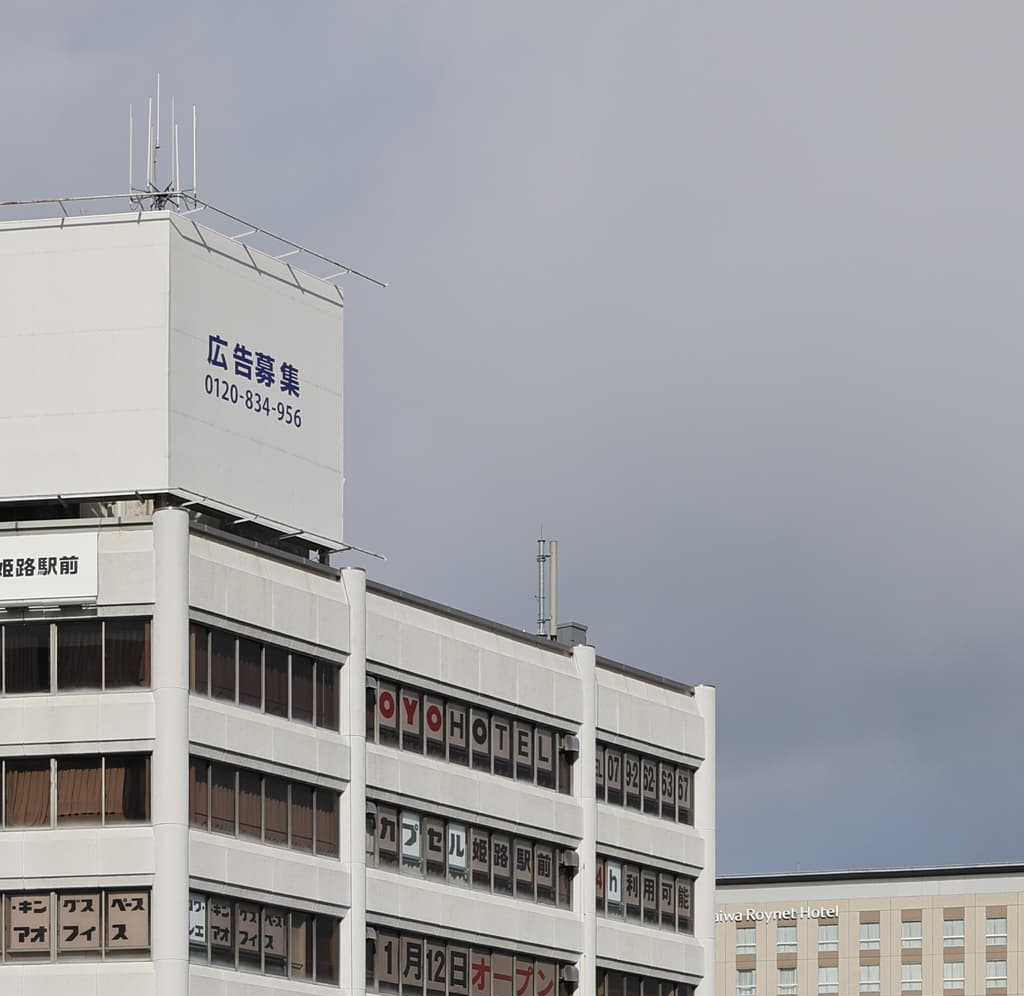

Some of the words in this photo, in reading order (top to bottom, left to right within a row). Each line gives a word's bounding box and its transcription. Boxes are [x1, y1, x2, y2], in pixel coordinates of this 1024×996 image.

[207, 334, 301, 398] 広告募集
[204, 374, 302, 428] 0120-834-956
[746, 907, 796, 927] Roynet
[800, 905, 839, 919] Hotel
